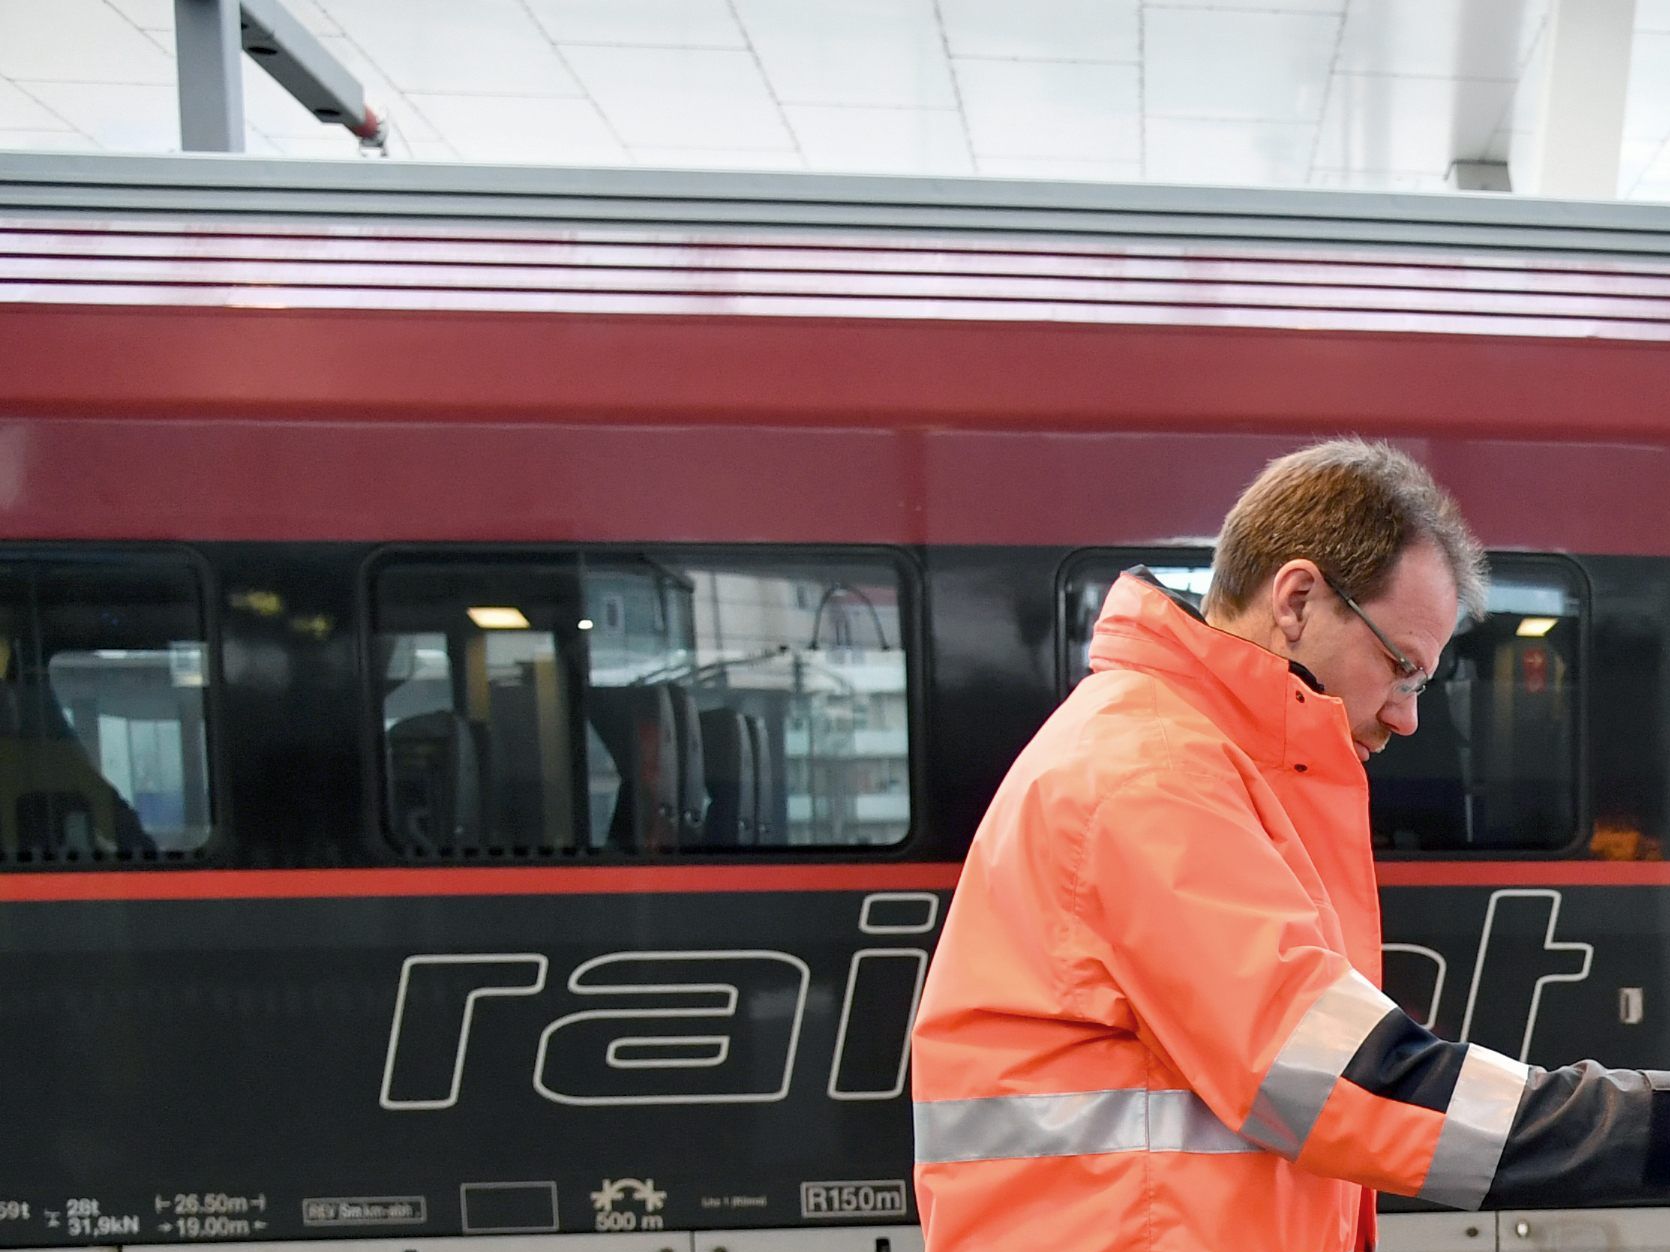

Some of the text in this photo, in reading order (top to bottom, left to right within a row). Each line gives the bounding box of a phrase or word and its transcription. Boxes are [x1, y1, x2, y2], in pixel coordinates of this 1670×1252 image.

[66, 1197, 101, 1218] 28t
[806, 1185, 901, 1213] R150m
[67, 1216, 140, 1237] 31,9kN
[176, 1216, 250, 1237] 19.00m
[595, 1211, 664, 1232] 500 m
